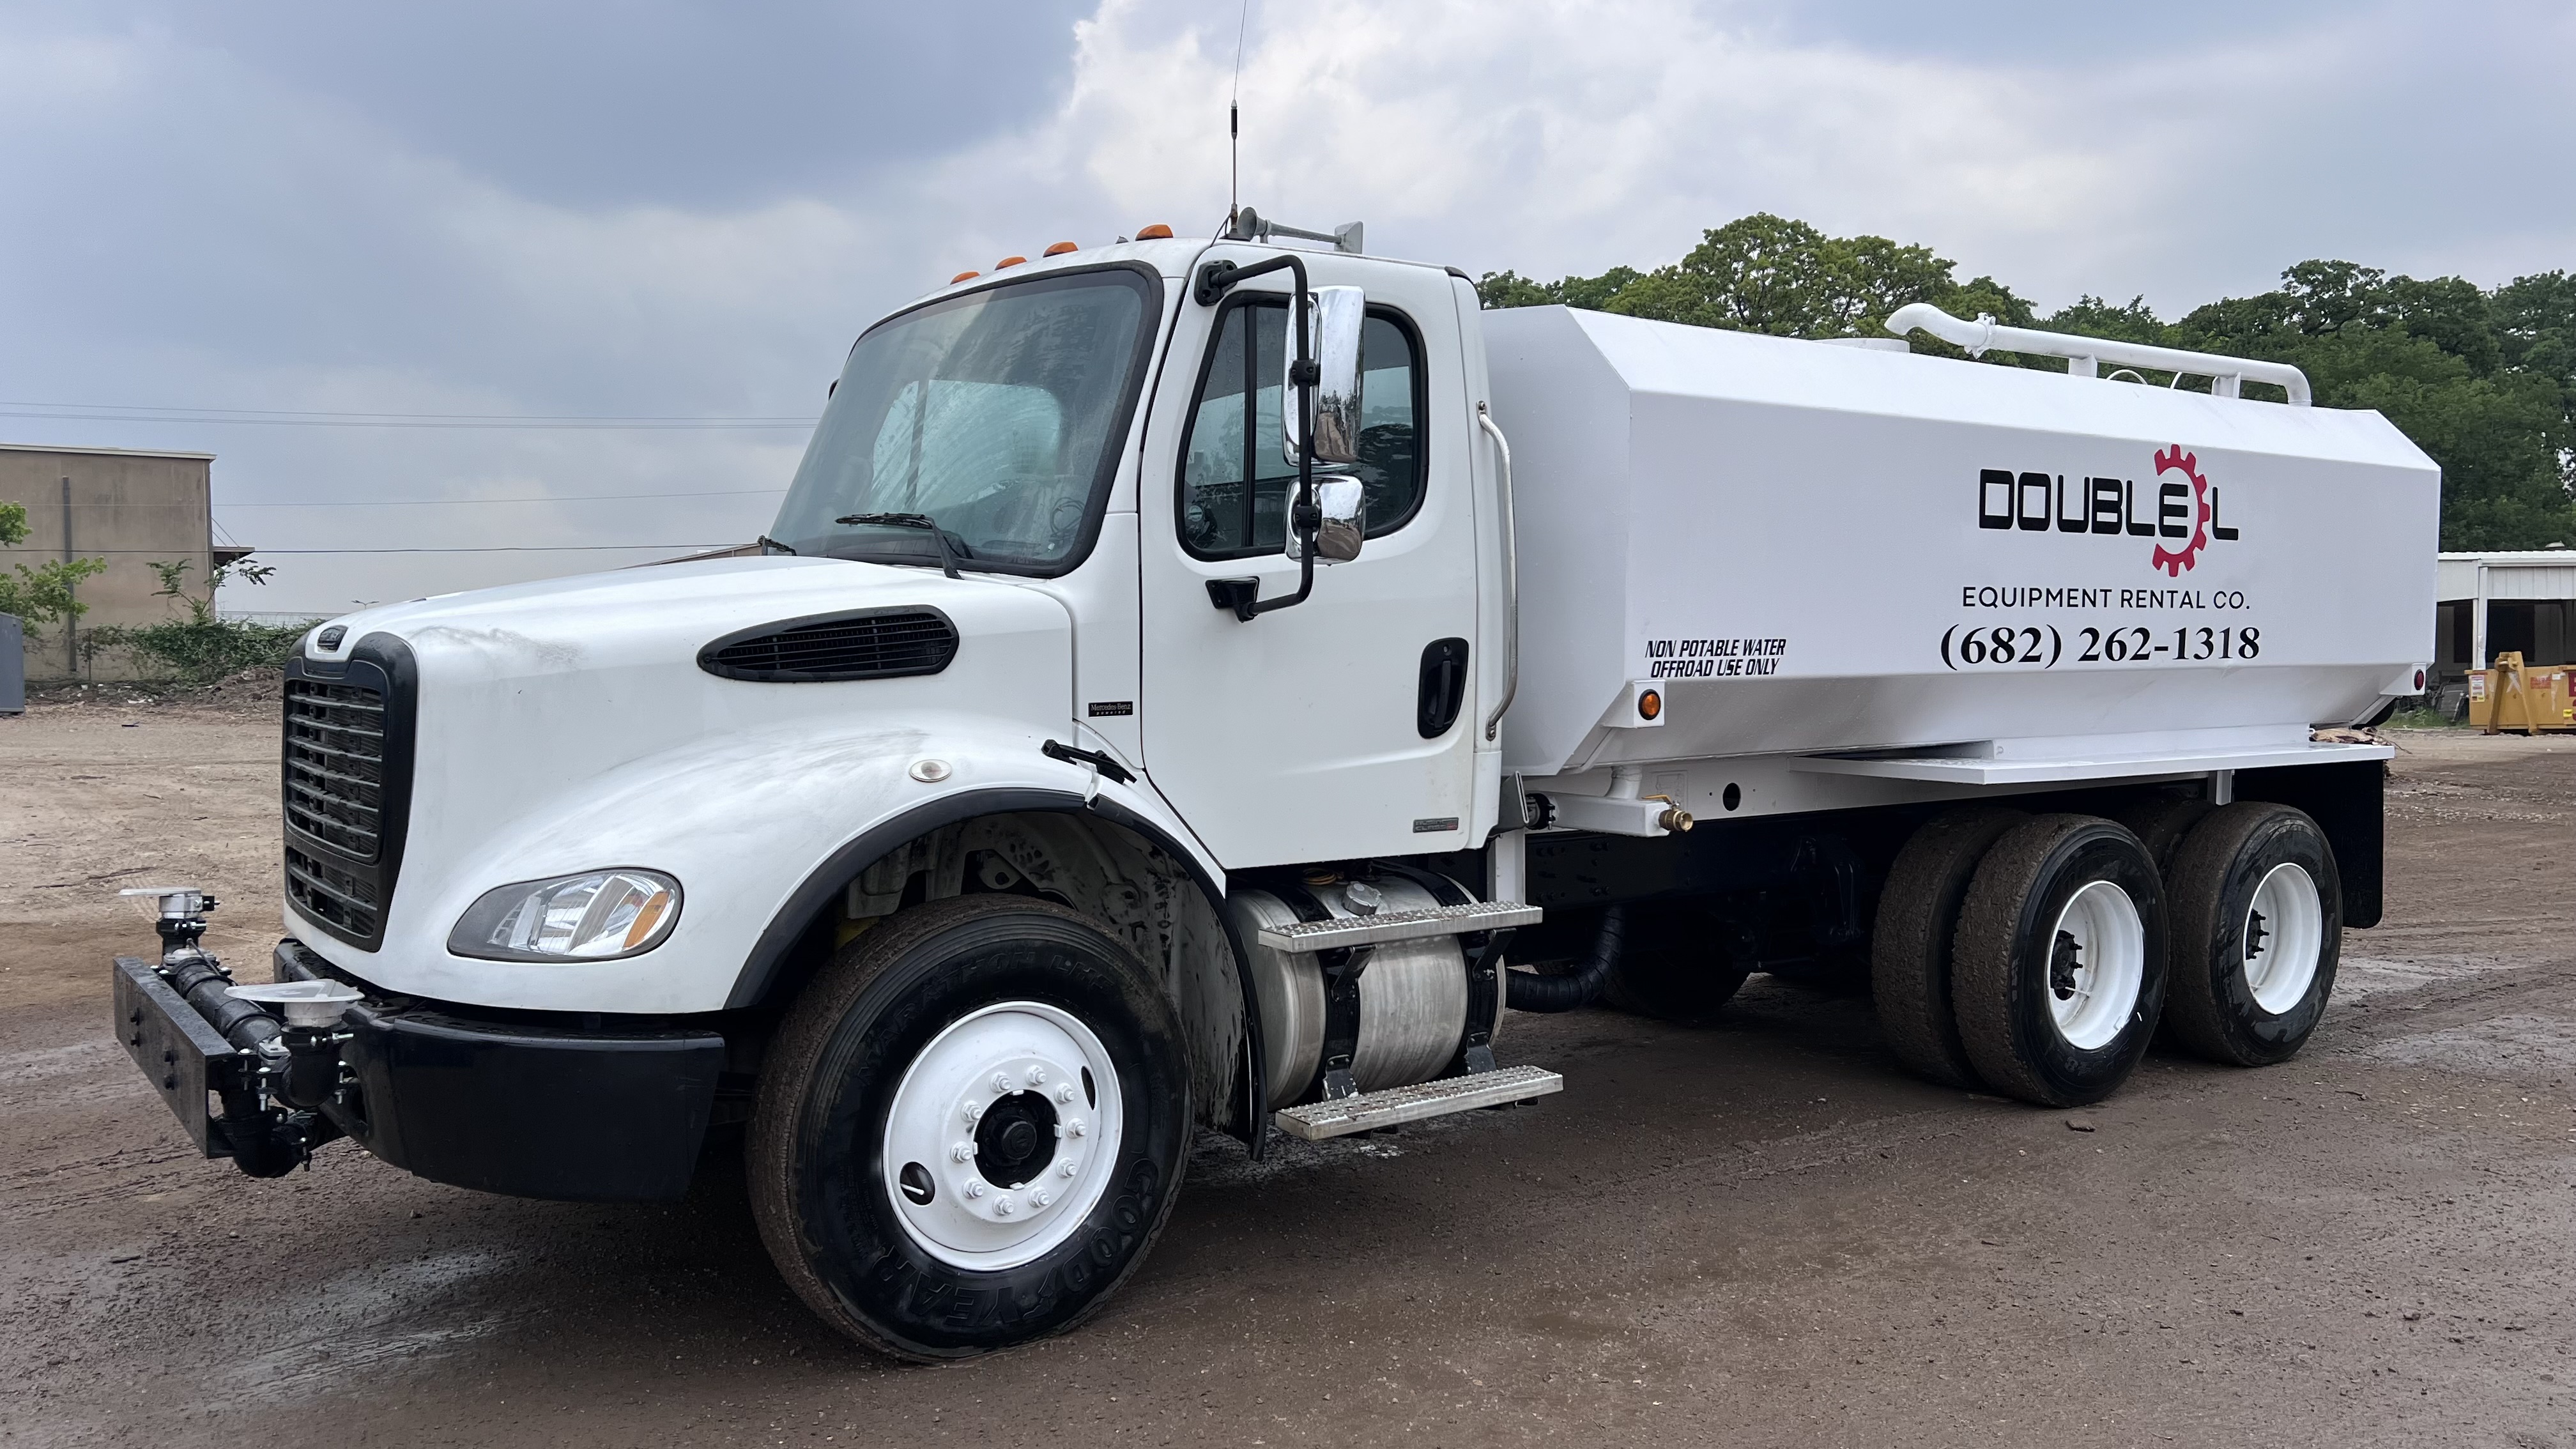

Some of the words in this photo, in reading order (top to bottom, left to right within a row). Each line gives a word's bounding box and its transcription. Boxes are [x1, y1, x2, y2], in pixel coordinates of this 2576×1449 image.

[1979, 469, 2189, 539] DOUBLE
[2212, 486, 2239, 541] L
[1962, 586, 2112, 609] EQUIPMENT
[2120, 588, 2206, 610] RENTAL
[2212, 590, 2250, 610] CO.
[1644, 640, 1677, 658] NON
[1678, 639, 1740, 658] POTABLE
[1742, 638, 1787, 657] WATER
[1940, 624, 2062, 671] (682)
[2077, 626, 2260, 663] 262-1318
[1650, 659, 1714, 678] OFFROAD
[1716, 658, 1744, 677] USE
[1745, 657, 1781, 676] ONLY
